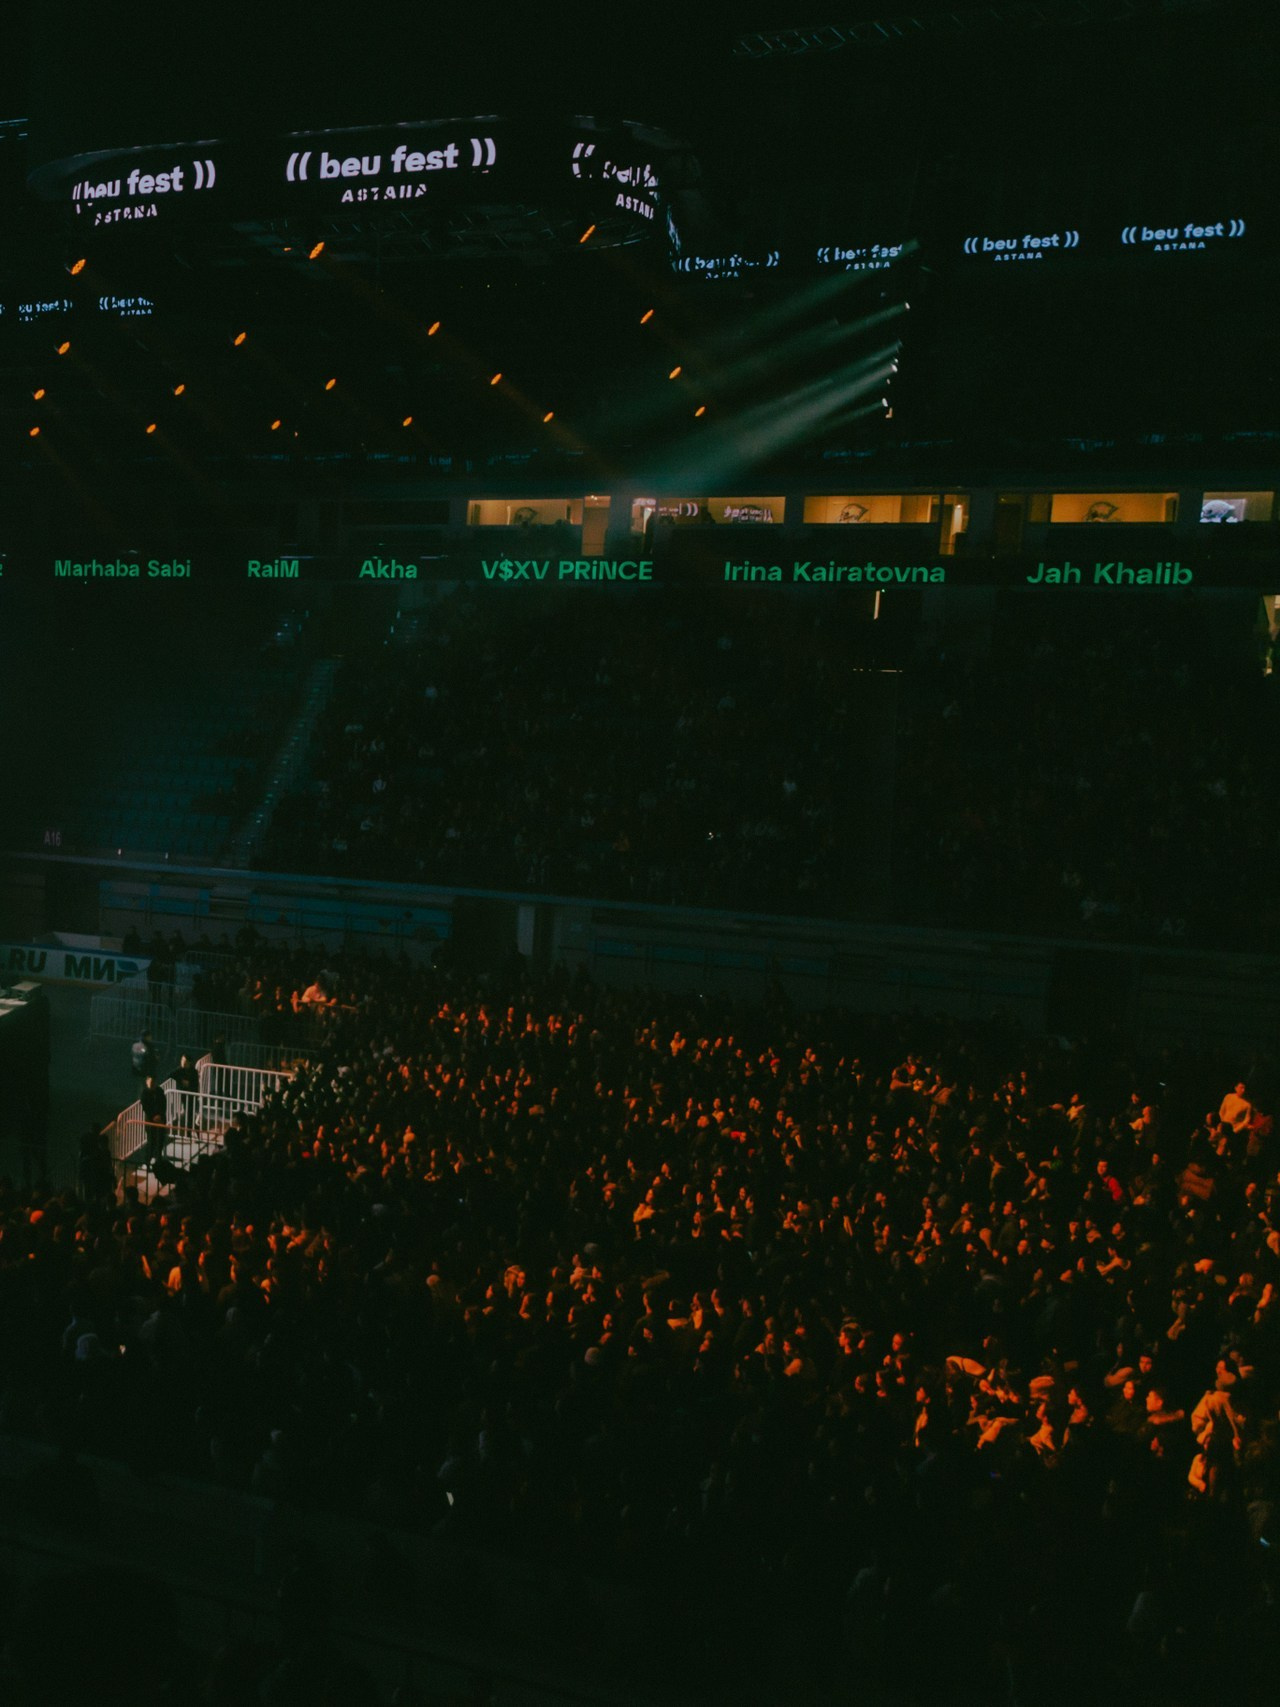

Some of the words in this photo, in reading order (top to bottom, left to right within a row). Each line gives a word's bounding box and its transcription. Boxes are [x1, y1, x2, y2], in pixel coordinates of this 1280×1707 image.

[320, 152, 381, 179] beu
[391, 143, 459, 173] fest
[127, 168, 184, 196] fest
[1141, 226, 1179, 241] beu
[1184, 222, 1224, 238] fest
[982, 237, 1017, 251] beu
[1022, 234, 1060, 249] fest
[1154, 241, 1206, 251] ASTANA
[994, 251, 1043, 261] ASTANA
[55, 559, 140, 578] Marhaba
[147, 559, 192, 578] Sabi
[247, 560, 300, 578] RaiM
[359, 559, 418, 579] Akha
[481, 560, 550, 582] V$XV
[723, 561, 783, 583] Irina
[793, 561, 946, 584] Kairatovna
[1026, 562, 1081, 585] Jah
[1094, 562, 1194, 585] Khalib
